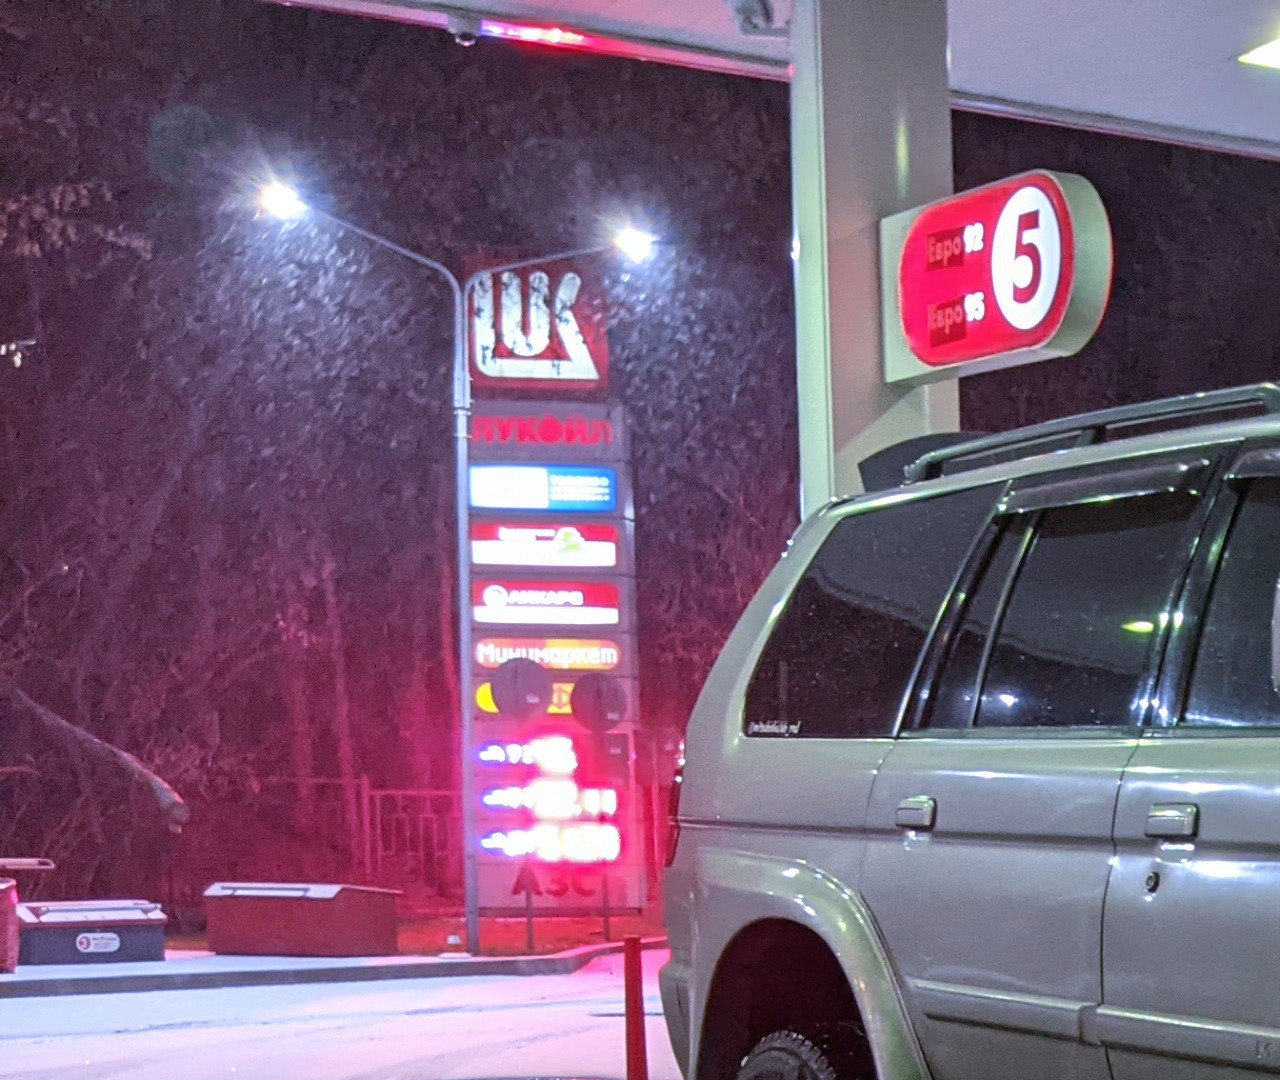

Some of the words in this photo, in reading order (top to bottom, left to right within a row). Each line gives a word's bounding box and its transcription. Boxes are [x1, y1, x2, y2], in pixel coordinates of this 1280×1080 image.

[927, 236, 962, 267] Евро
[1012, 207, 1043, 304] 5
[927, 304, 963, 335] Евро
